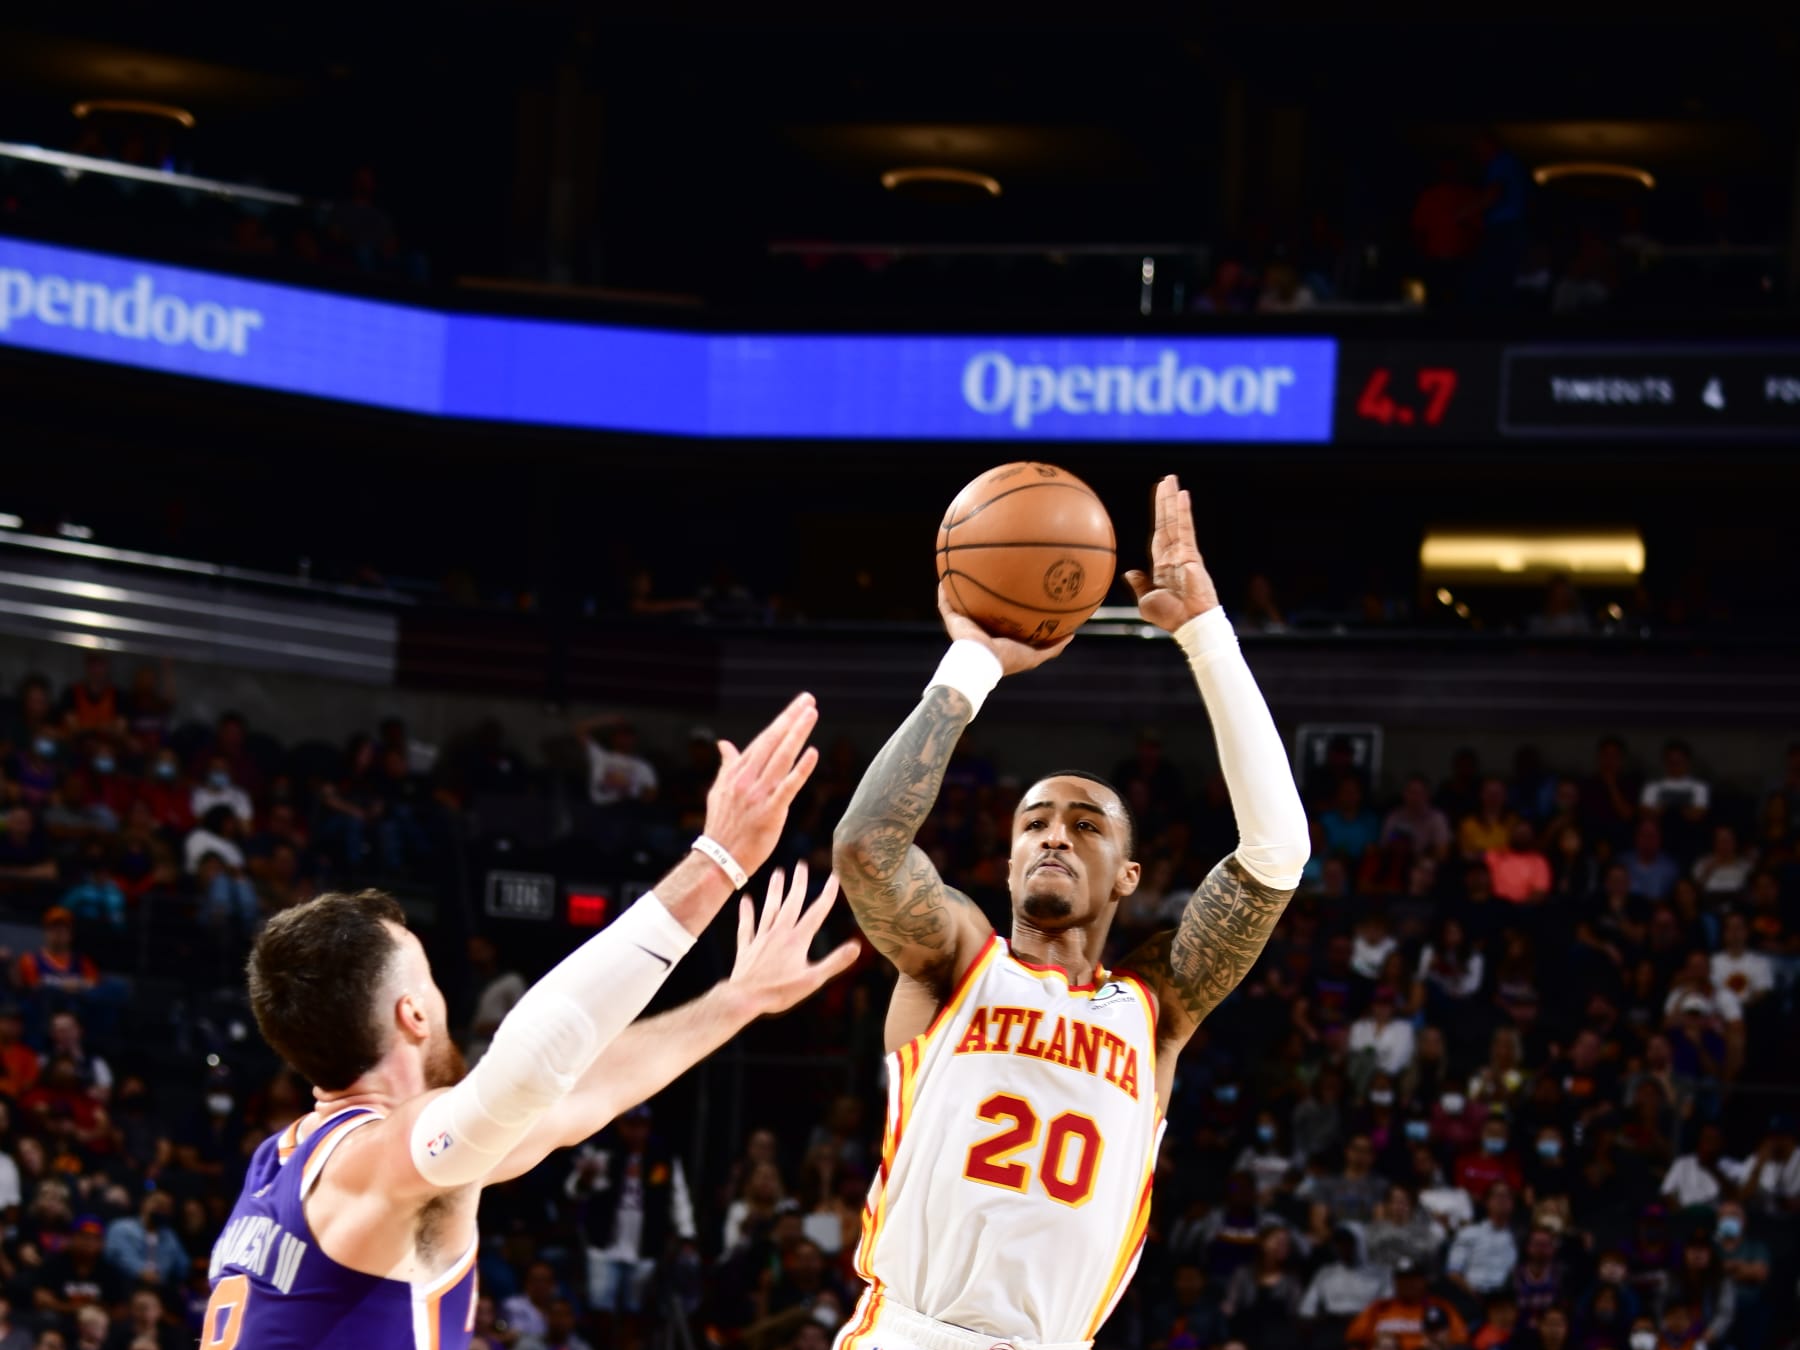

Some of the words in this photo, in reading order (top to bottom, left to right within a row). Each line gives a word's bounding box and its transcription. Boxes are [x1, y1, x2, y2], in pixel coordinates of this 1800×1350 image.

[961, 347, 1296, 430] Opendoor
[1357, 367, 1458, 426] 4.7
[952, 1004, 1139, 1105] ATLANTA
[961, 1090, 1105, 1209] 20
[271, 1231, 307, 1295] III
